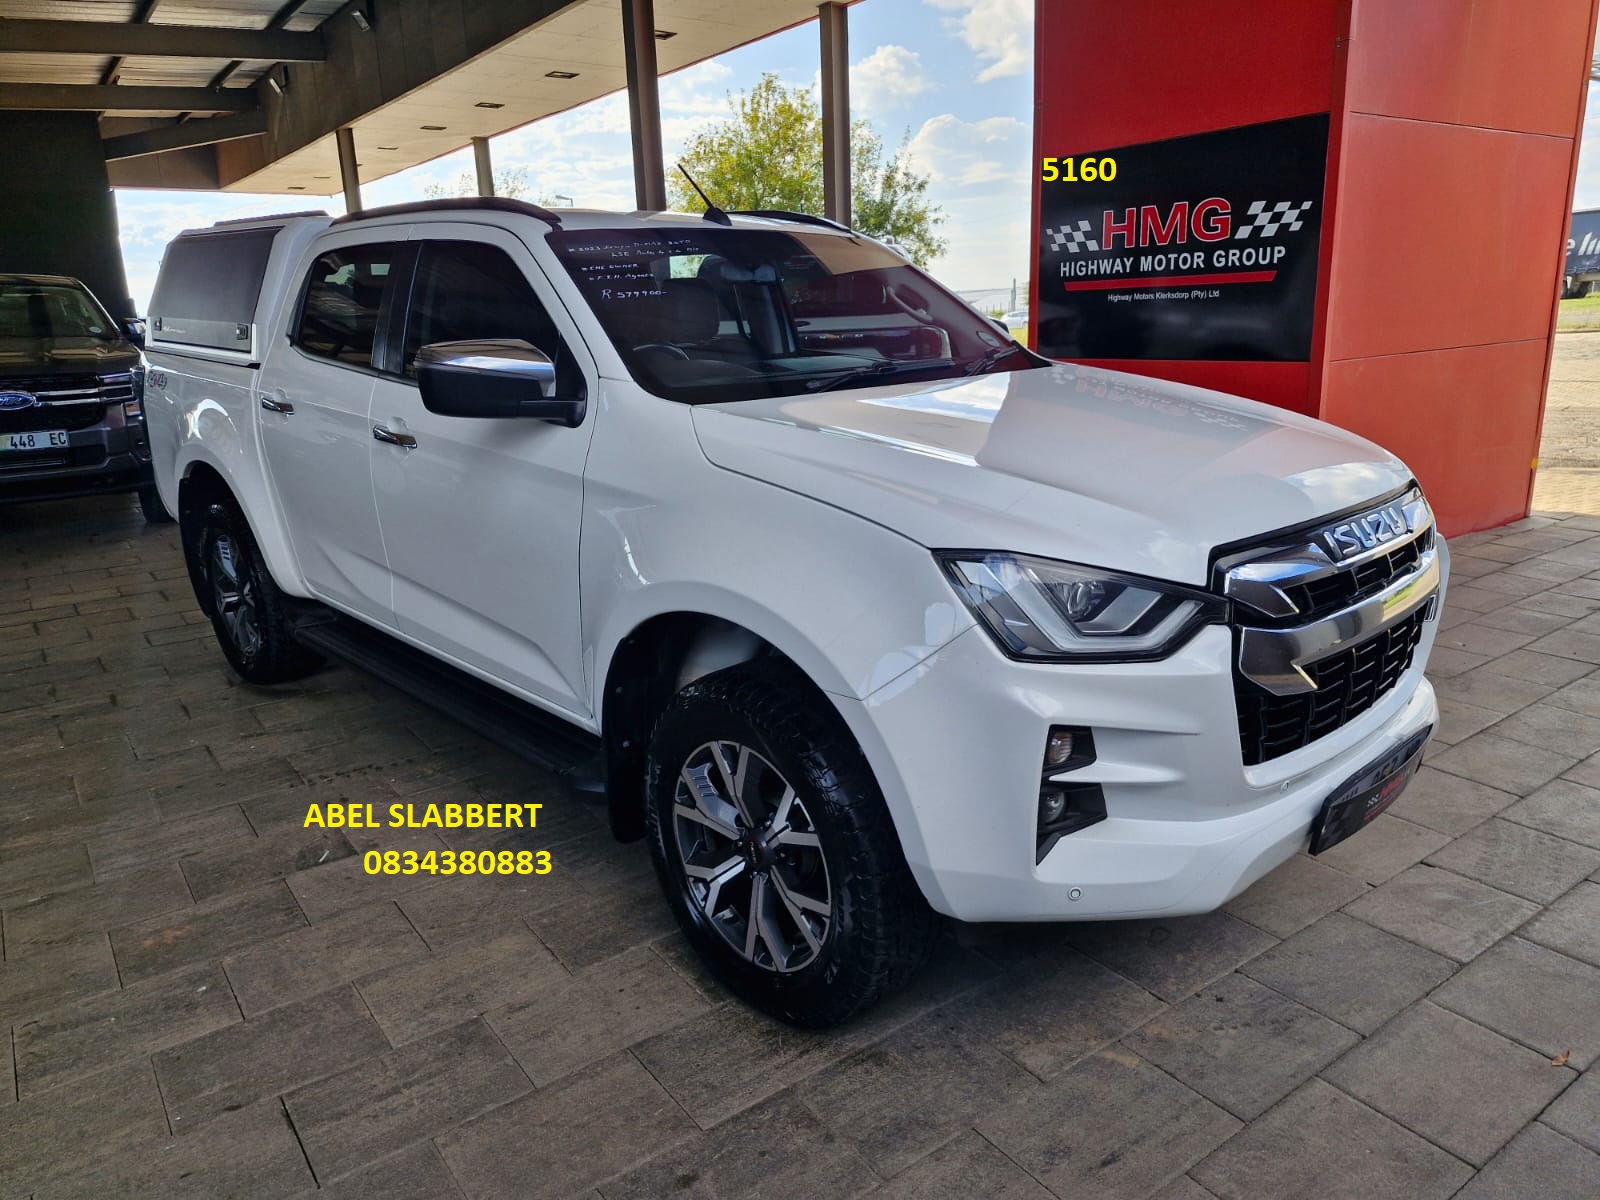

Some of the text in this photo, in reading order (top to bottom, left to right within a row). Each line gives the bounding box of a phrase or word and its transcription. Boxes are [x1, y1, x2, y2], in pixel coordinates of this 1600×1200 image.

[1102, 197, 1232, 250] HMG
[1060, 246, 1286, 277] HIGHWAY MOTOR GROUP
[601, 288, 613, 301] R
[1107, 289, 1220, 303] Highway Motors Klerksdorp (Pty) Ltd
[49, 432, 67, 446] EC
[1323, 507, 1407, 560] ISUZU
